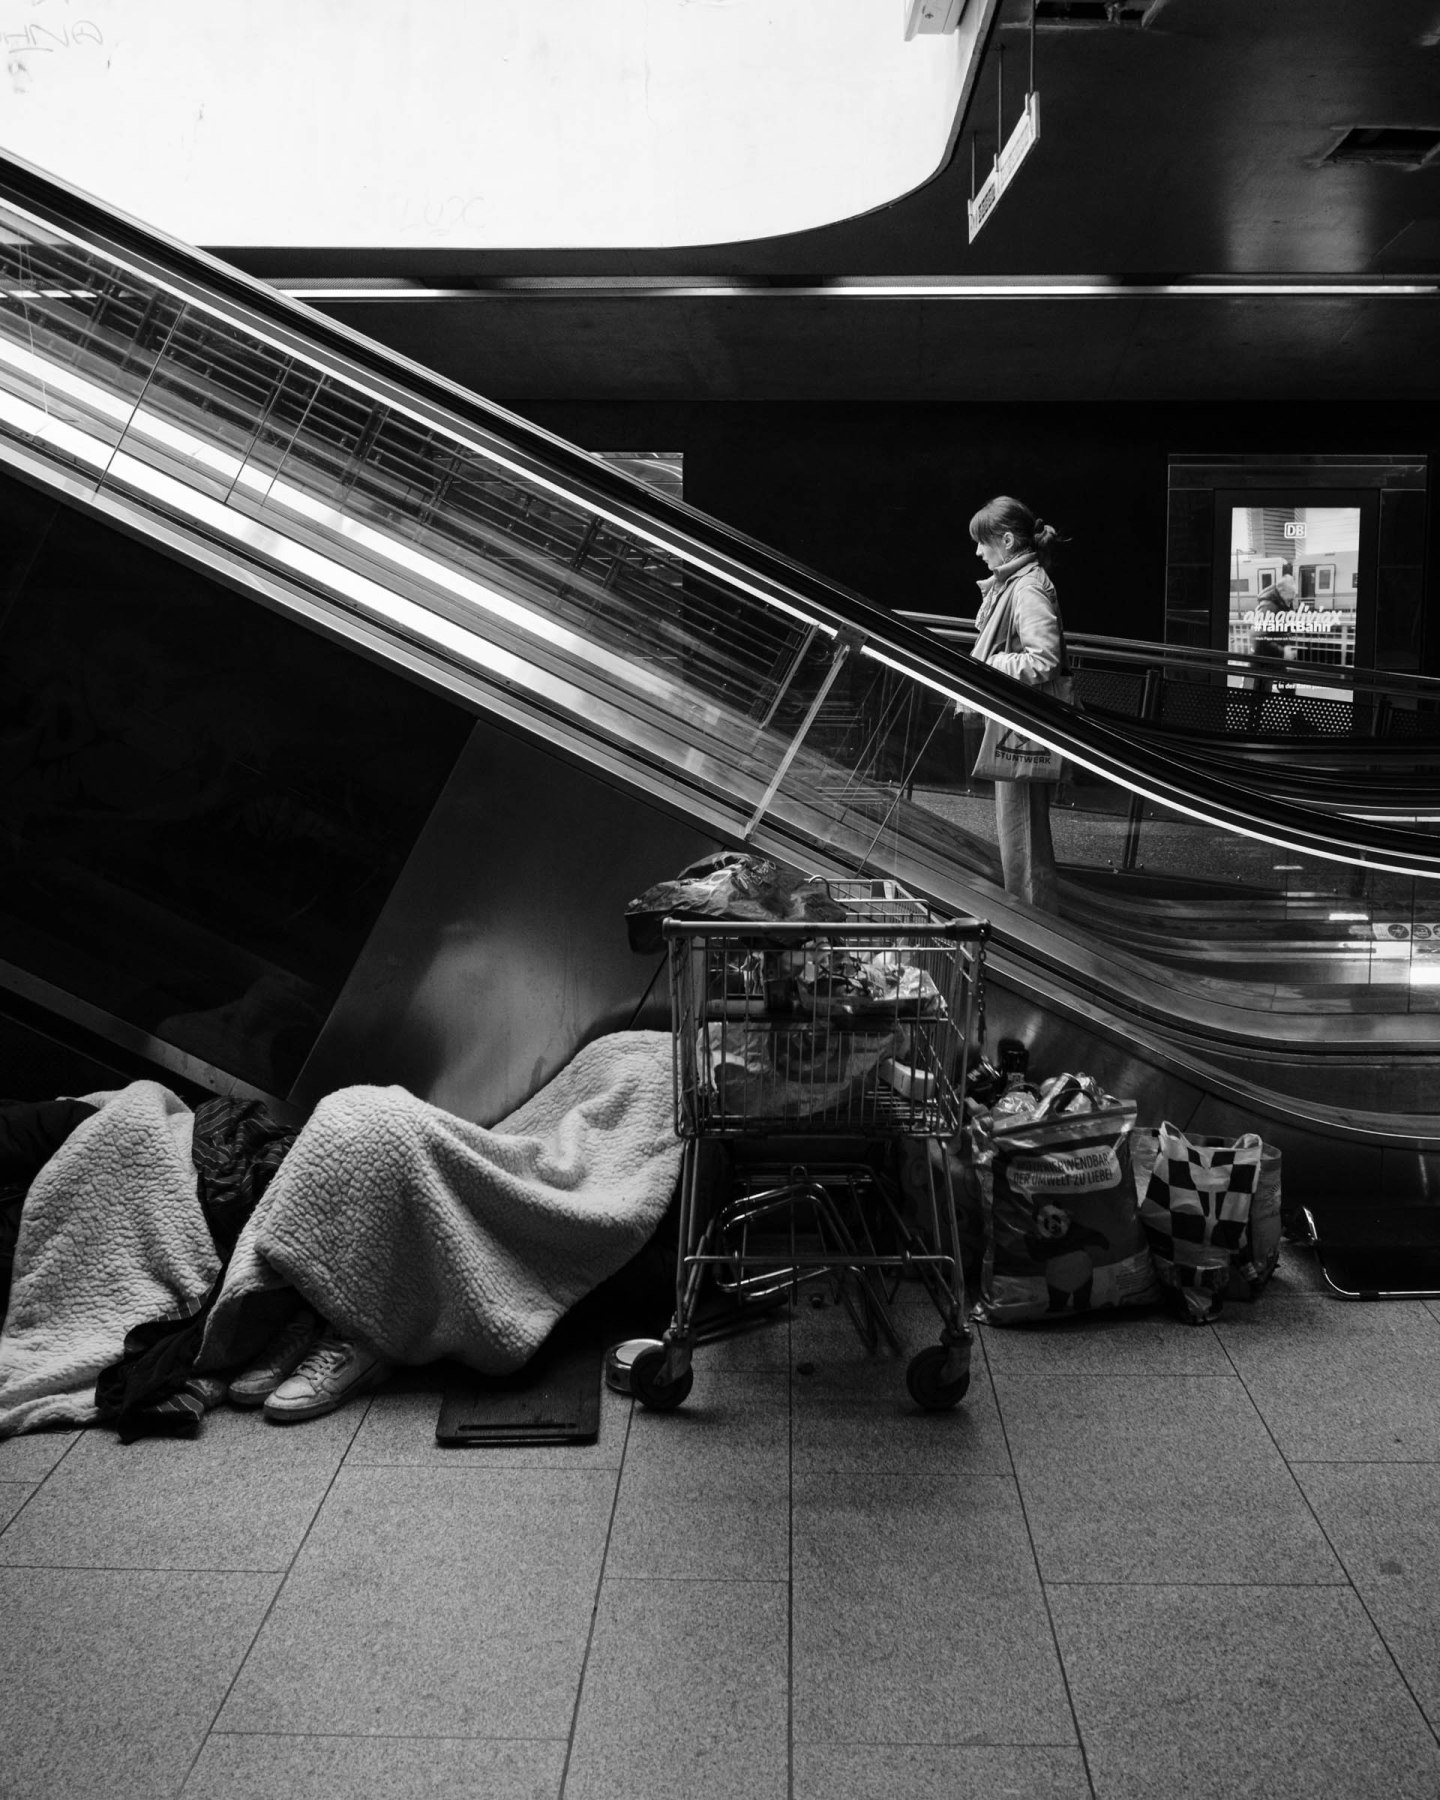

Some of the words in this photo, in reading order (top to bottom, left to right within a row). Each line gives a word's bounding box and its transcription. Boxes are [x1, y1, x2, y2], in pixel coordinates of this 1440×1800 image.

[1286, 525, 1304, 536] DB
[995, 750, 1051, 764] STUNTWERK
[1013, 1172, 1031, 1186] DER
[1031, 1173, 1071, 1187] UMWELT
[1073, 1173, 1086, 1186] ZU
[1087, 1168, 1113, 1184] LIEBE!
